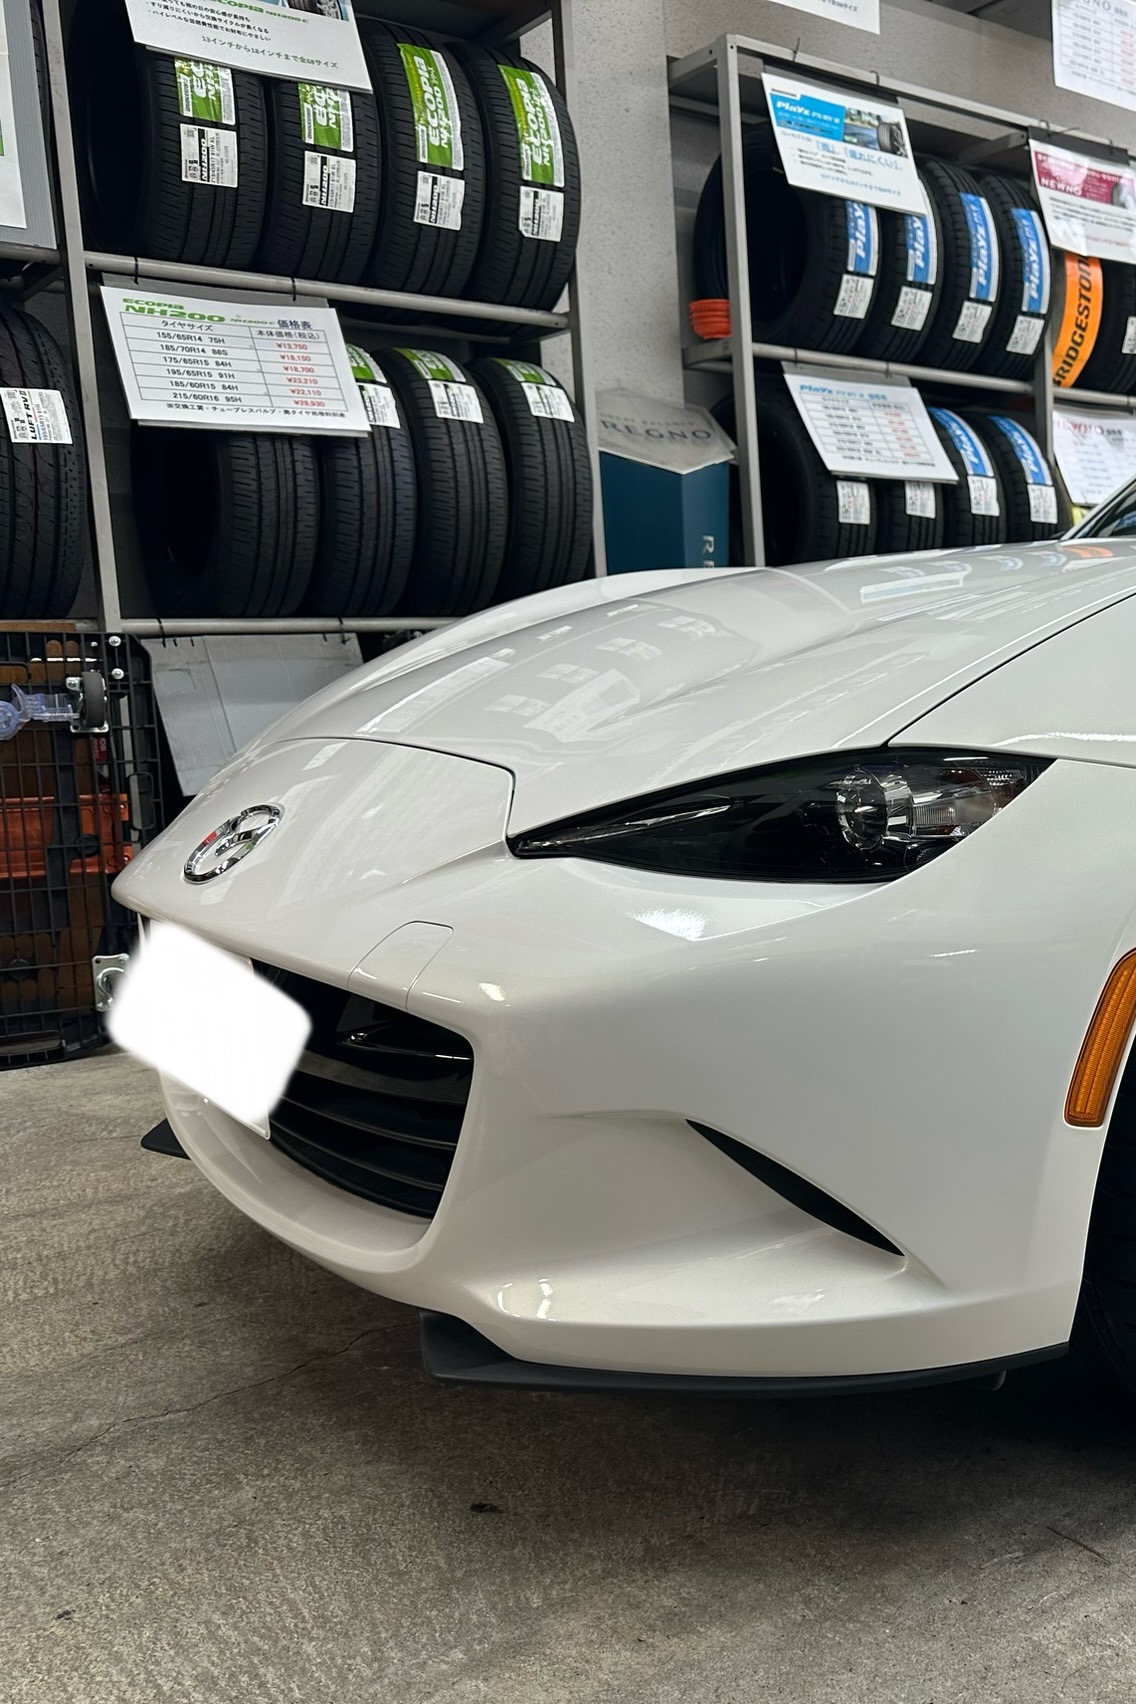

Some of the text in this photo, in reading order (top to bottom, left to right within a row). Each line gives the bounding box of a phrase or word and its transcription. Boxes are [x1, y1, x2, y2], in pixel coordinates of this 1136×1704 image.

[125, 304, 226, 323] NH200
[277, 319, 314, 330] 価格表
[161, 319, 214, 332] タイヤサイズ
[157, 332, 226, 344] 155/65R14 75H
[160, 344, 228, 357] 185/70R14 88S
[163, 356, 232, 368] 175/65R15 84H
[166, 368, 235, 380] 195/65R15 91H
[170, 380, 239, 392] 185/60R15 84H
[173, 392, 242, 403] 215/60R16 95H
[25, 411, 37, 440] LUFT
[600, 420, 712, 440] REGNO
